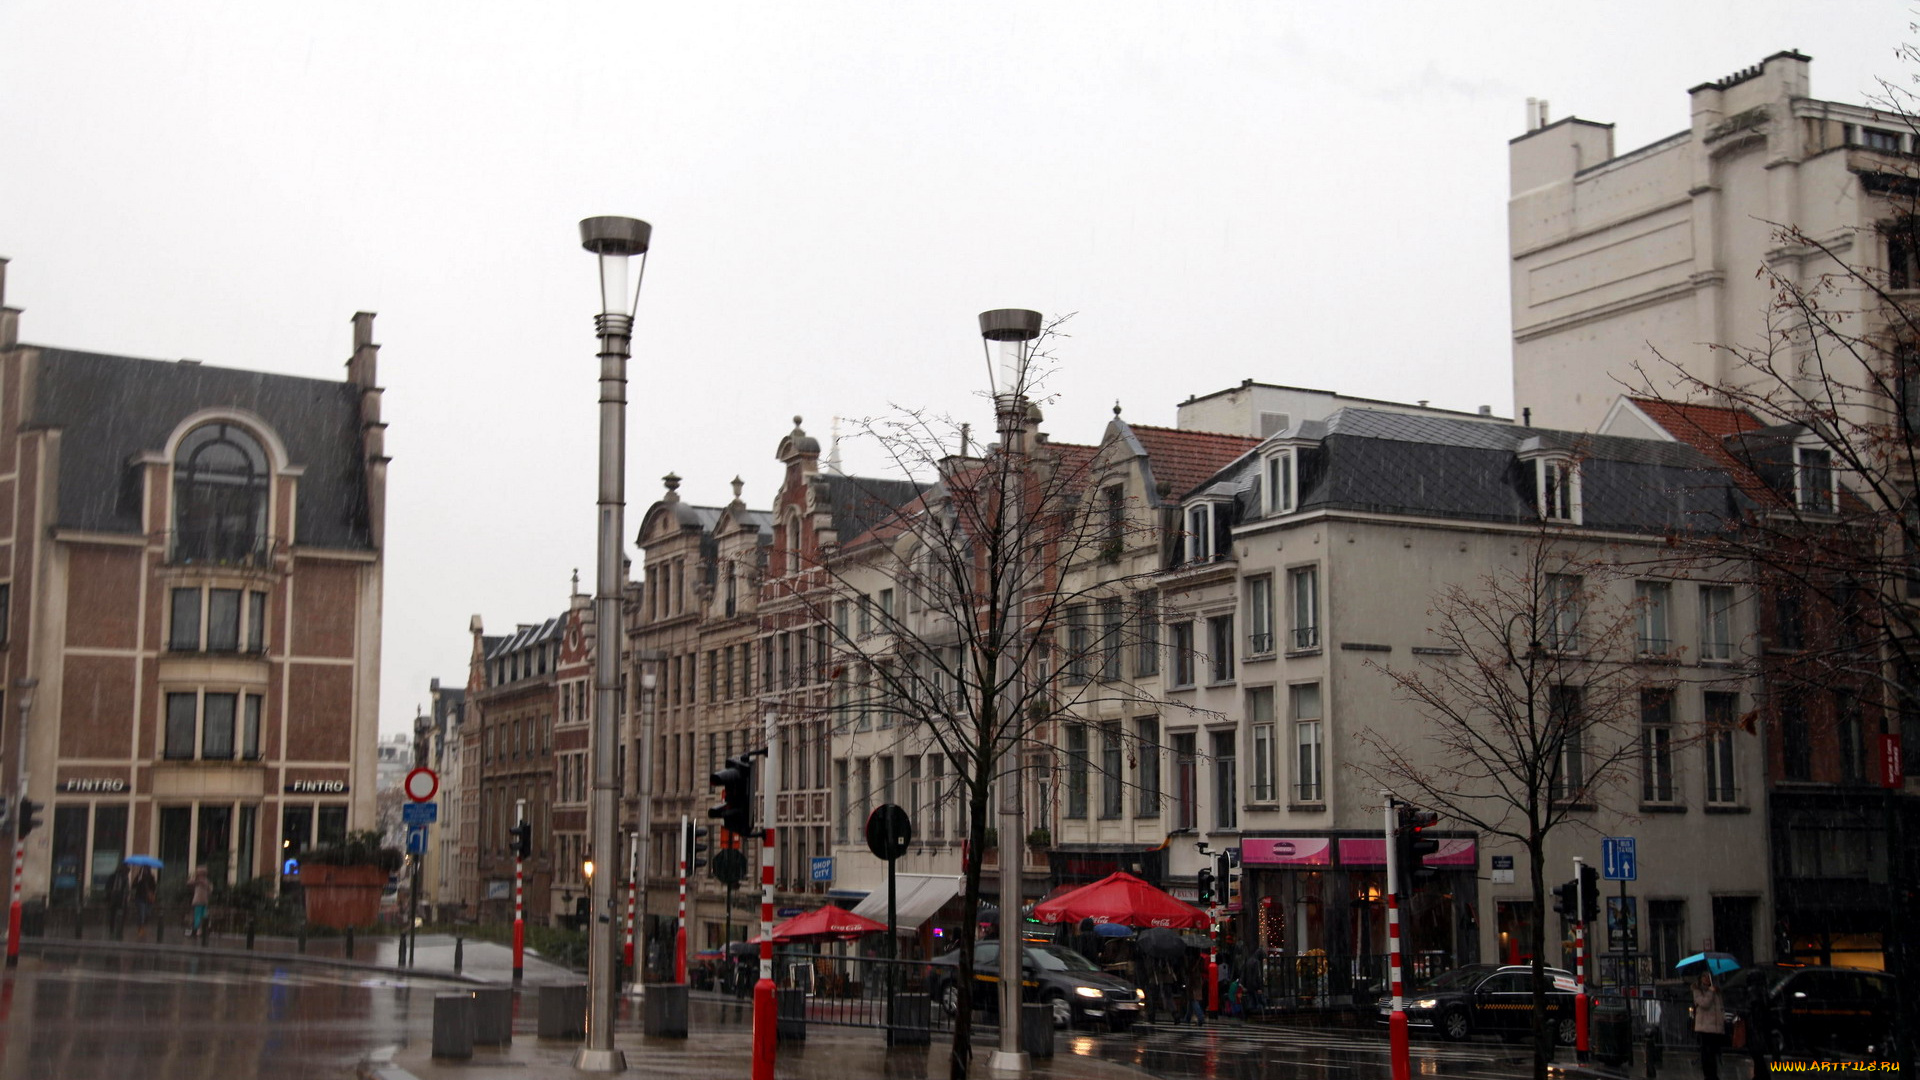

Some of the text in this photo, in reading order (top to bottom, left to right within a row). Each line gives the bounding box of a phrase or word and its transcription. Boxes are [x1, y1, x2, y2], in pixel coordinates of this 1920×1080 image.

[66, 777, 125, 791] FINTRO
[293, 779, 345, 792] FINTRO
[813, 860, 831, 870] SHOP
[814, 869, 829, 878] CITY
